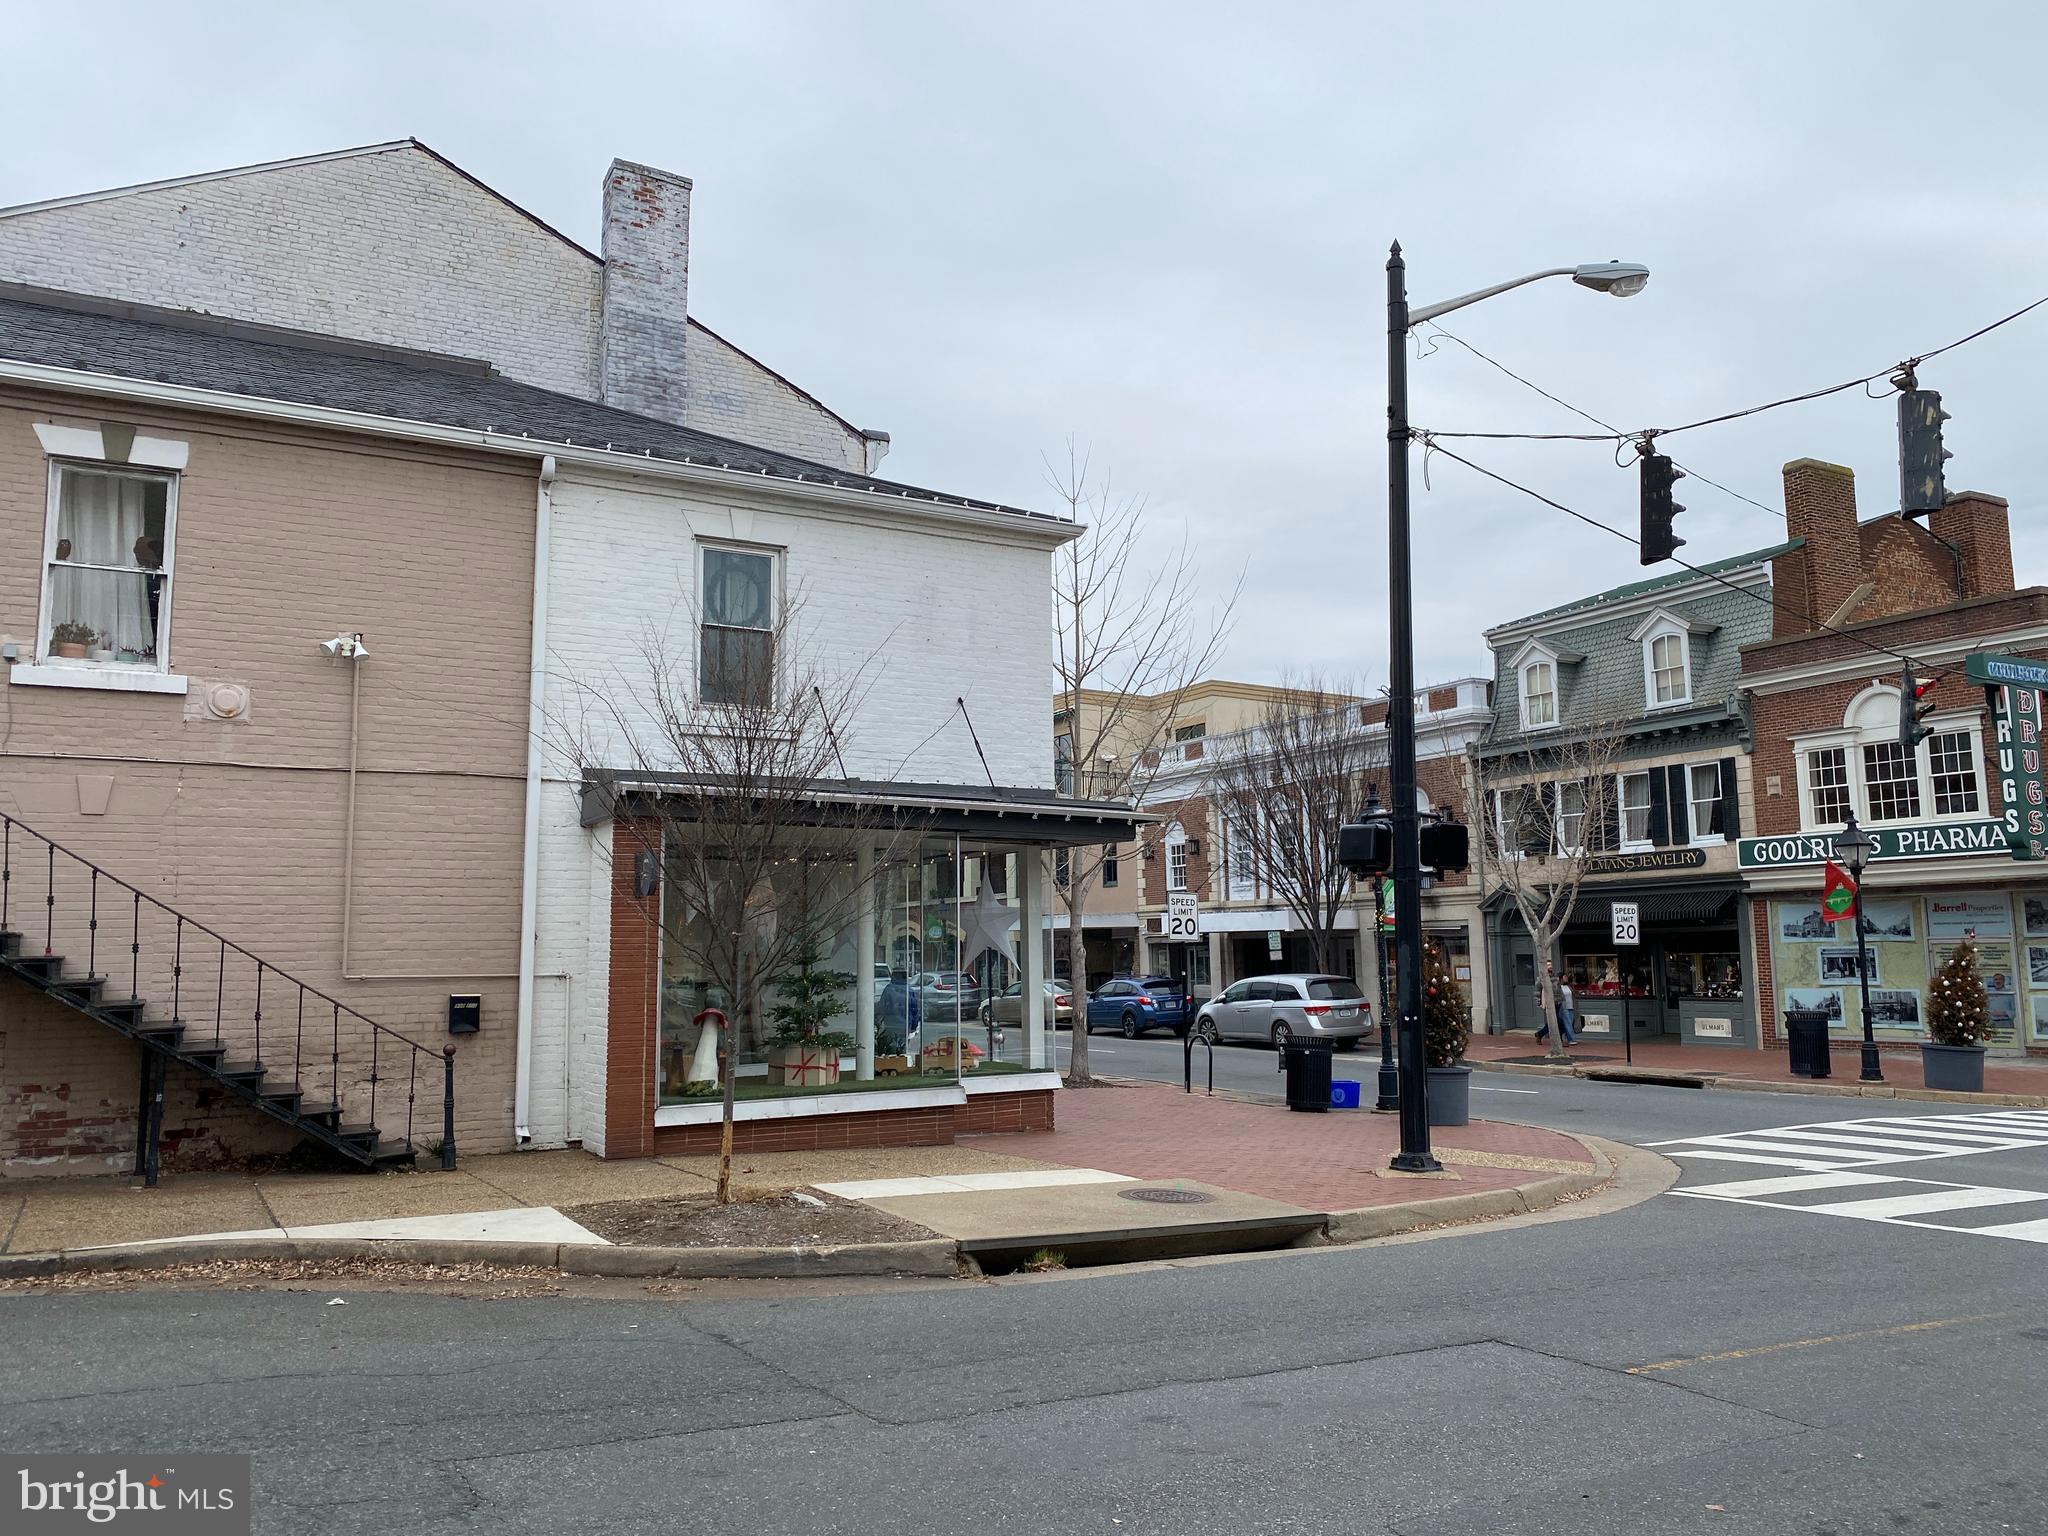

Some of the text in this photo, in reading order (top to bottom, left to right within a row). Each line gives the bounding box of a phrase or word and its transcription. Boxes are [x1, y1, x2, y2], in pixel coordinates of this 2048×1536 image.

[1994, 691, 2020, 833] DRUGS
[2016, 689, 2046, 835] DRUGS
[1753, 825, 2008, 863] GOOLRIS PHARMA
[1588, 851, 1700, 871] LMANS JEWELRY
[1170, 897, 1196, 907] SPEED
[1173, 907, 1194, 916] LIMIT
[1614, 907, 1636, 915] SPEED
[1171, 917, 1197, 936] 20
[1615, 924, 1637, 940] 20
